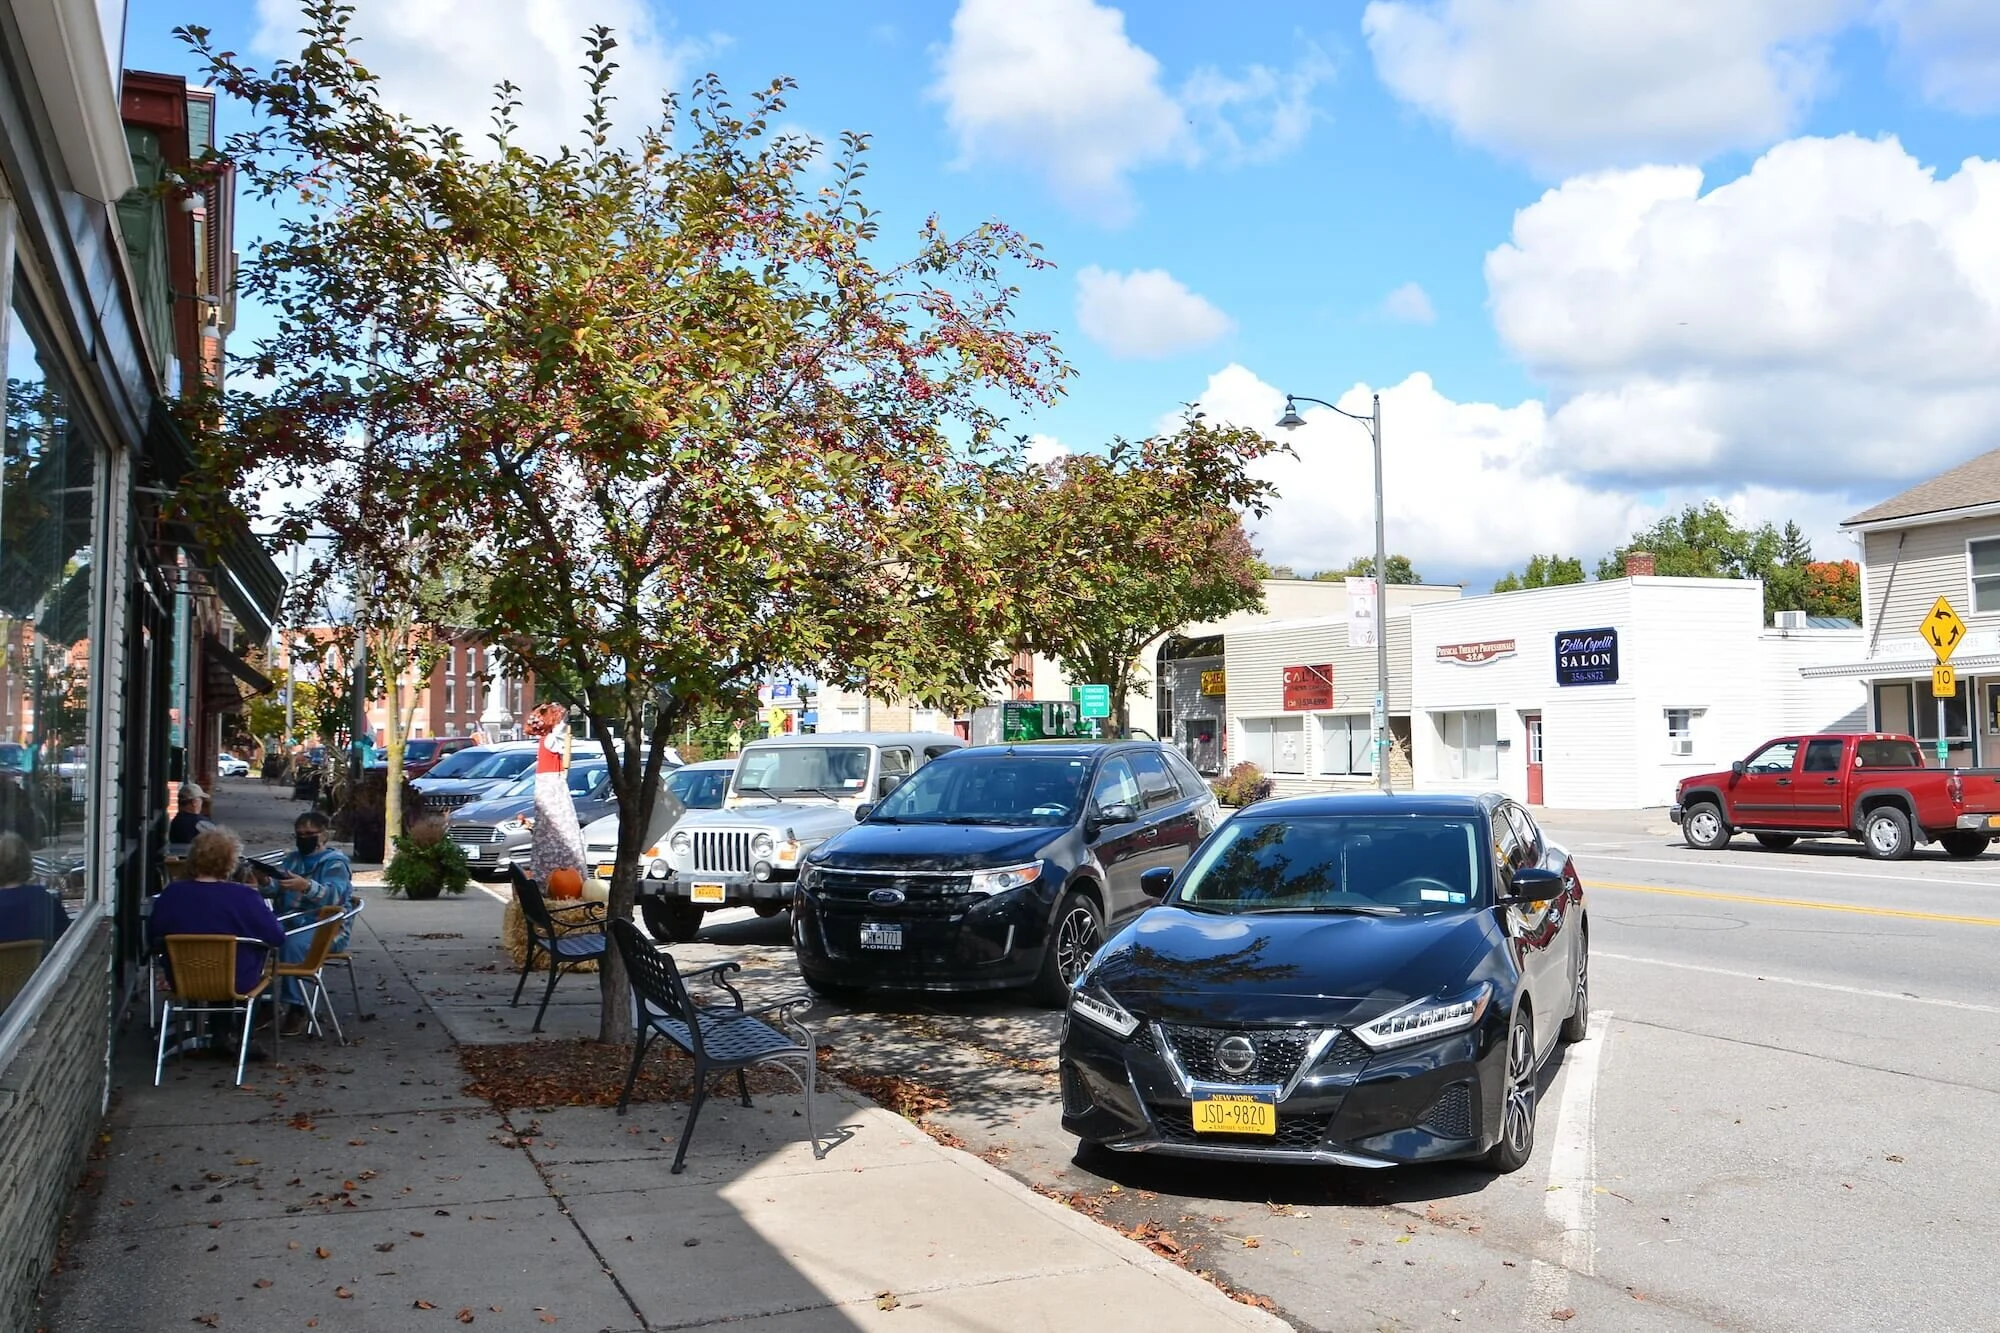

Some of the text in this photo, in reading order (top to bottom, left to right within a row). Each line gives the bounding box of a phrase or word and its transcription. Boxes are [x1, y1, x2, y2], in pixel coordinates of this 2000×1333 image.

[1561, 653, 1611, 667] SALON
[1936, 670, 1951, 684] 10
[1232, 1094, 1254, 1102] YORK
